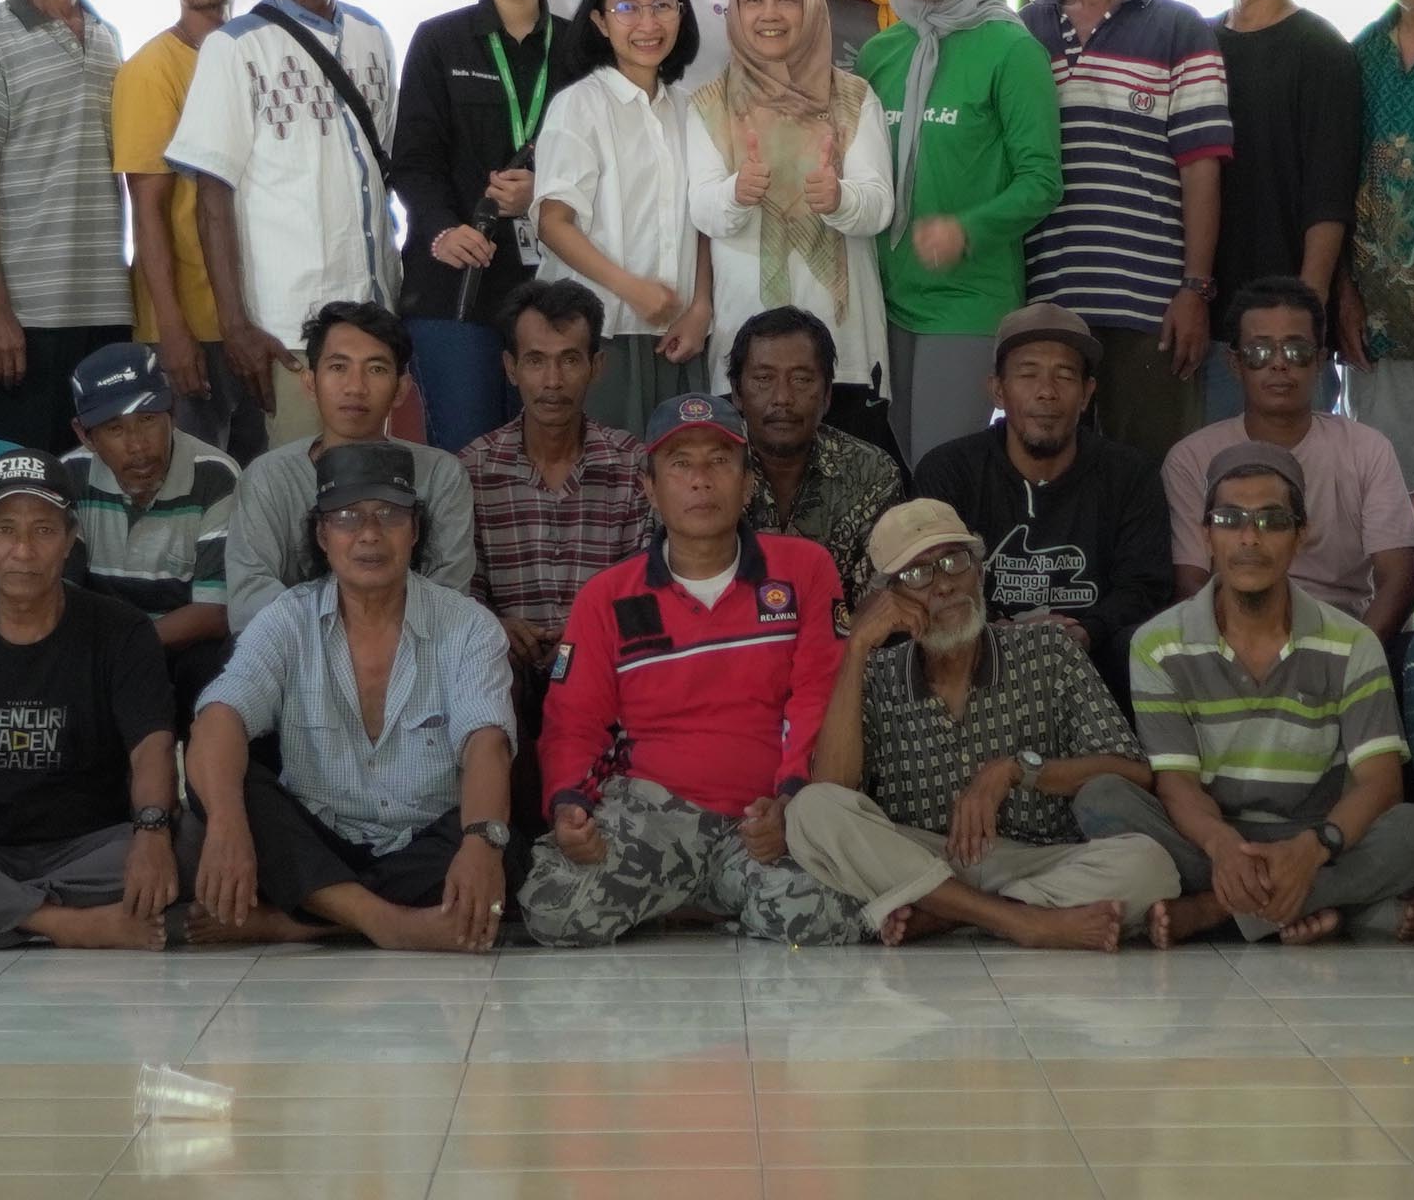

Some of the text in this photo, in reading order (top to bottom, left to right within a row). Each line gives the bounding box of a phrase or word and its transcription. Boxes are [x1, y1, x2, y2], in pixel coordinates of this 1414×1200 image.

[995, 554, 1083, 573] Ikan Aja Aku
[995, 571, 1050, 589] Tunggu
[993, 587, 1093, 605] Apalagi Kamu
[760, 612, 796, 622] RELAWAN
